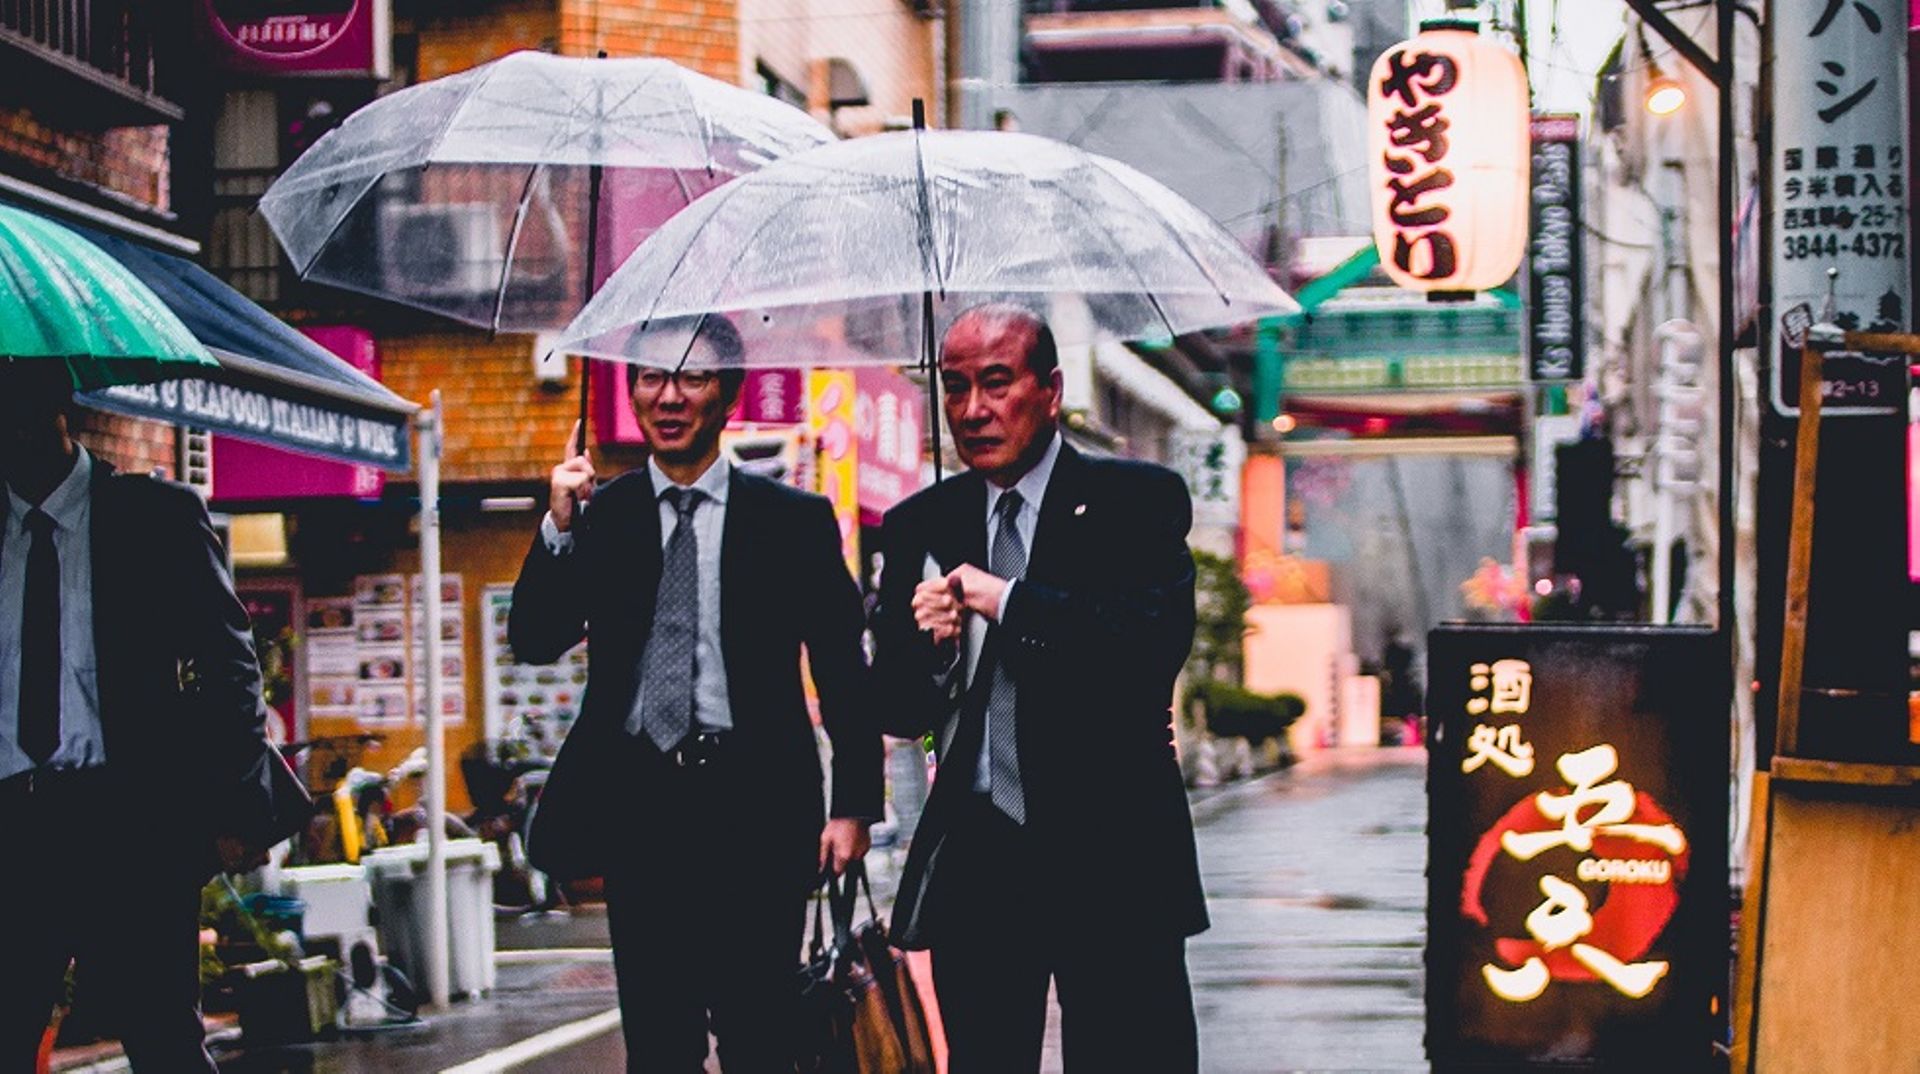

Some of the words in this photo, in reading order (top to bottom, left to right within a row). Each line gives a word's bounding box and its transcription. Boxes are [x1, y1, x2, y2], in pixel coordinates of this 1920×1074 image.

[1382, 49, 1459, 280] やきとり
[1533, 205, 1572, 273] Tokyo
[1784, 233, 1904, 259] 3844-4372
[1536, 273, 1573, 342] House
[182, 379, 271, 430] SEAFOOD
[271, 398, 340, 444] ITALIAN
[357, 418, 399, 457] WINE
[1462, 658, 1536, 777] 酒処
[1577, 858, 1672, 884] GOROKU
